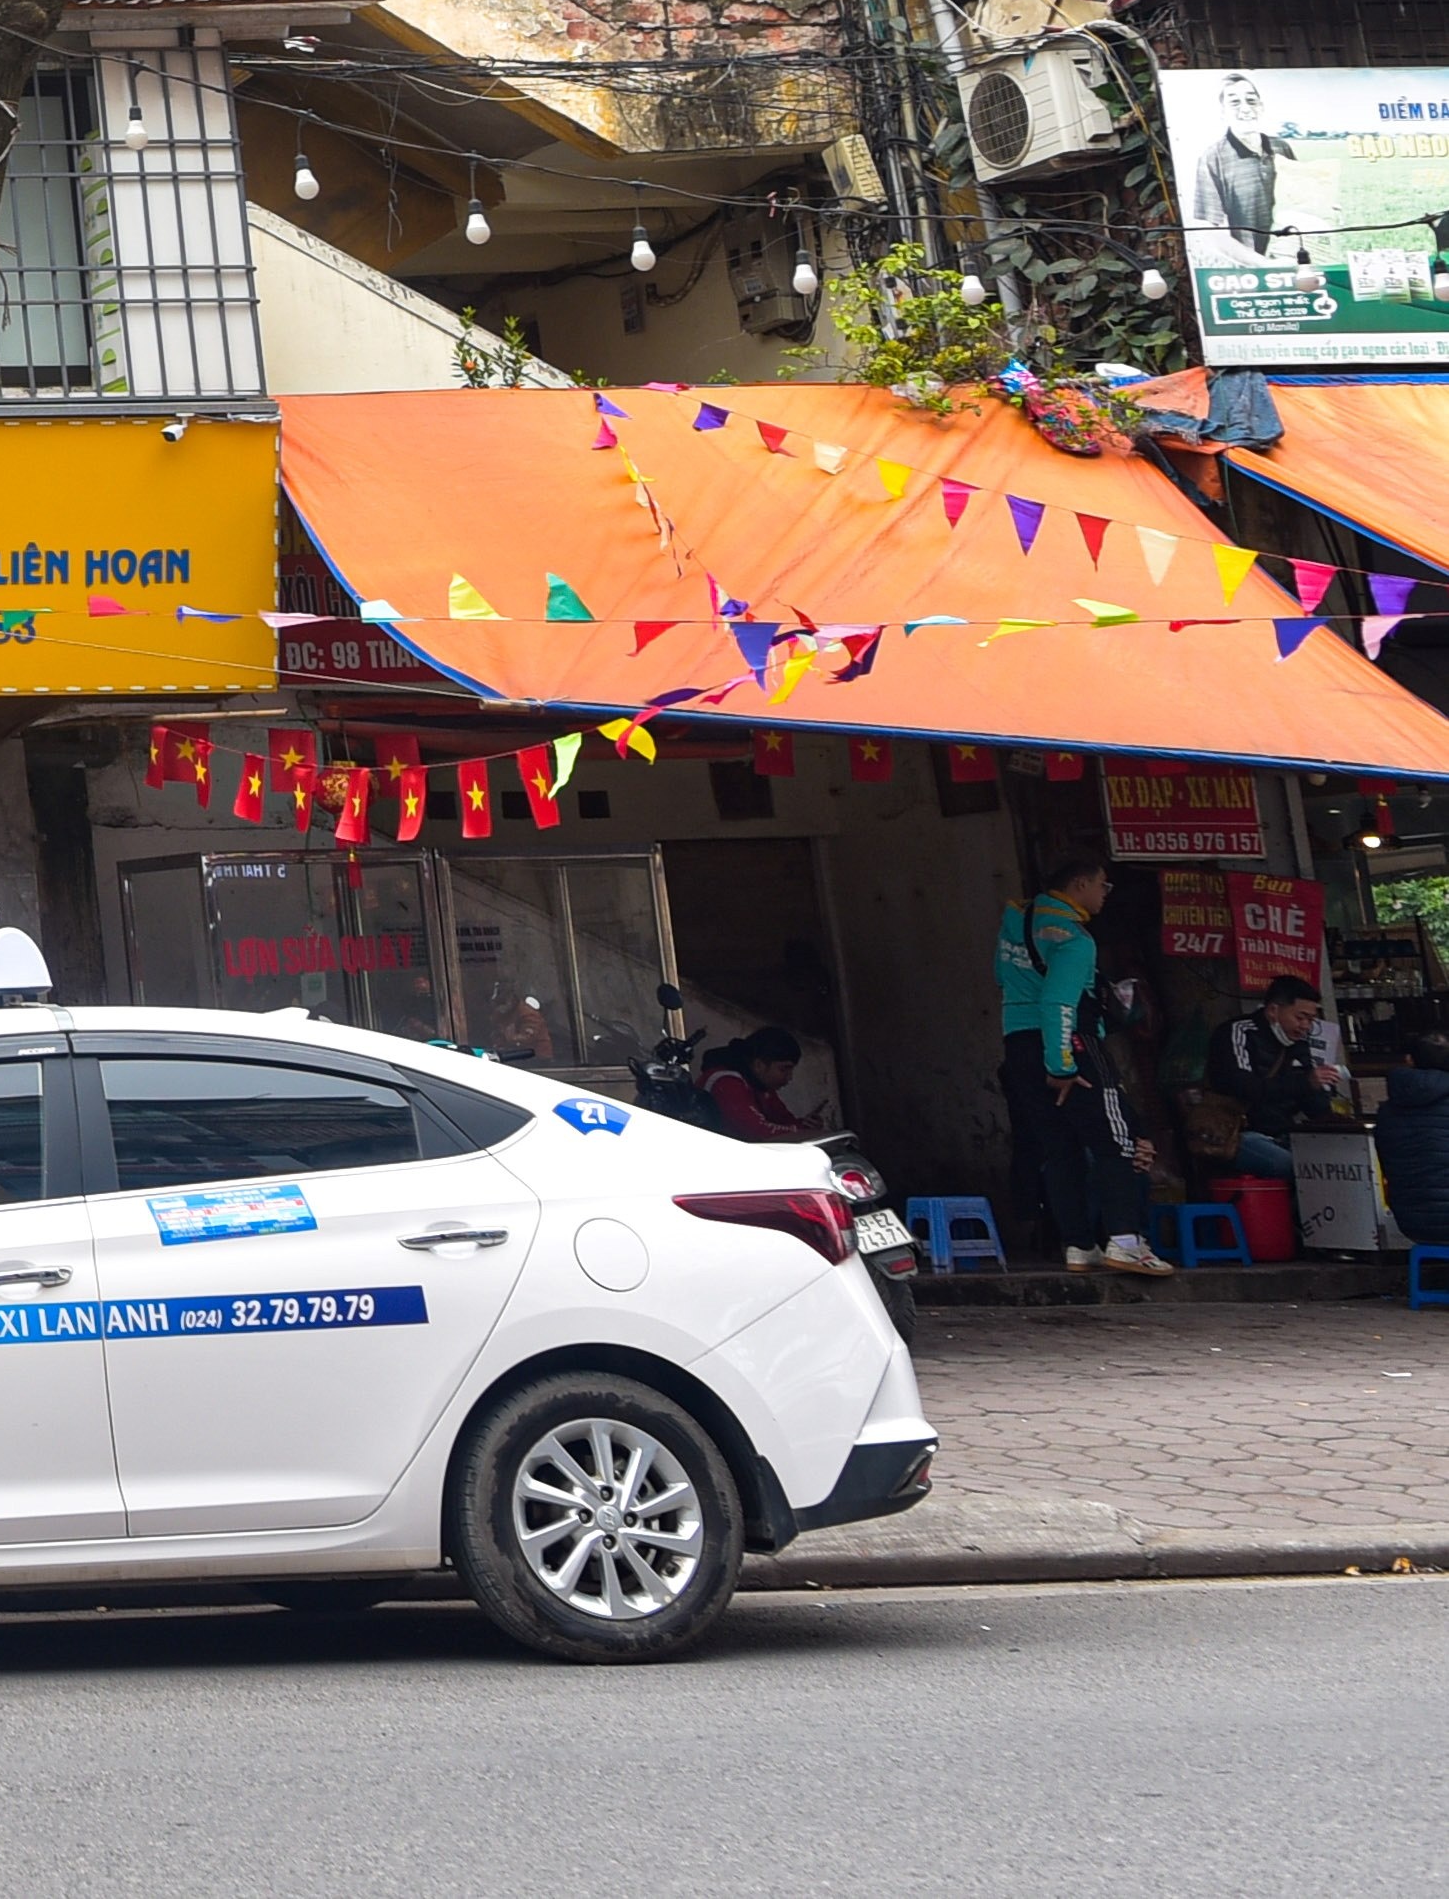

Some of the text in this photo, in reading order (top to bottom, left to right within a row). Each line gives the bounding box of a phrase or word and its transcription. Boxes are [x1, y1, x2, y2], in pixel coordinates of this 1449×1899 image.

[1378, 95, 1424, 119] ĐIỂM
[1208, 270, 1327, 295] GẠO ST5
[85, 548, 190, 587] HOAN
[285, 641, 361, 671] ĐC: 98
[1107, 776, 1135, 809] XE
[1185, 776, 1214, 809] XE
[1114, 832, 1261, 851] LH: 0356 976 157
[1243, 902, 1307, 938] CHÈ
[1172, 932, 1225, 953] 24/7
[222, 935, 281, 985] LỢN
[339, 933, 414, 977] QUAY
[39, 1305, 97, 1337] LAN
[106, 1302, 169, 1335] ANH
[179, 1307, 223, 1331] (024)
[231, 1293, 376, 1329] 32.79.79.79
